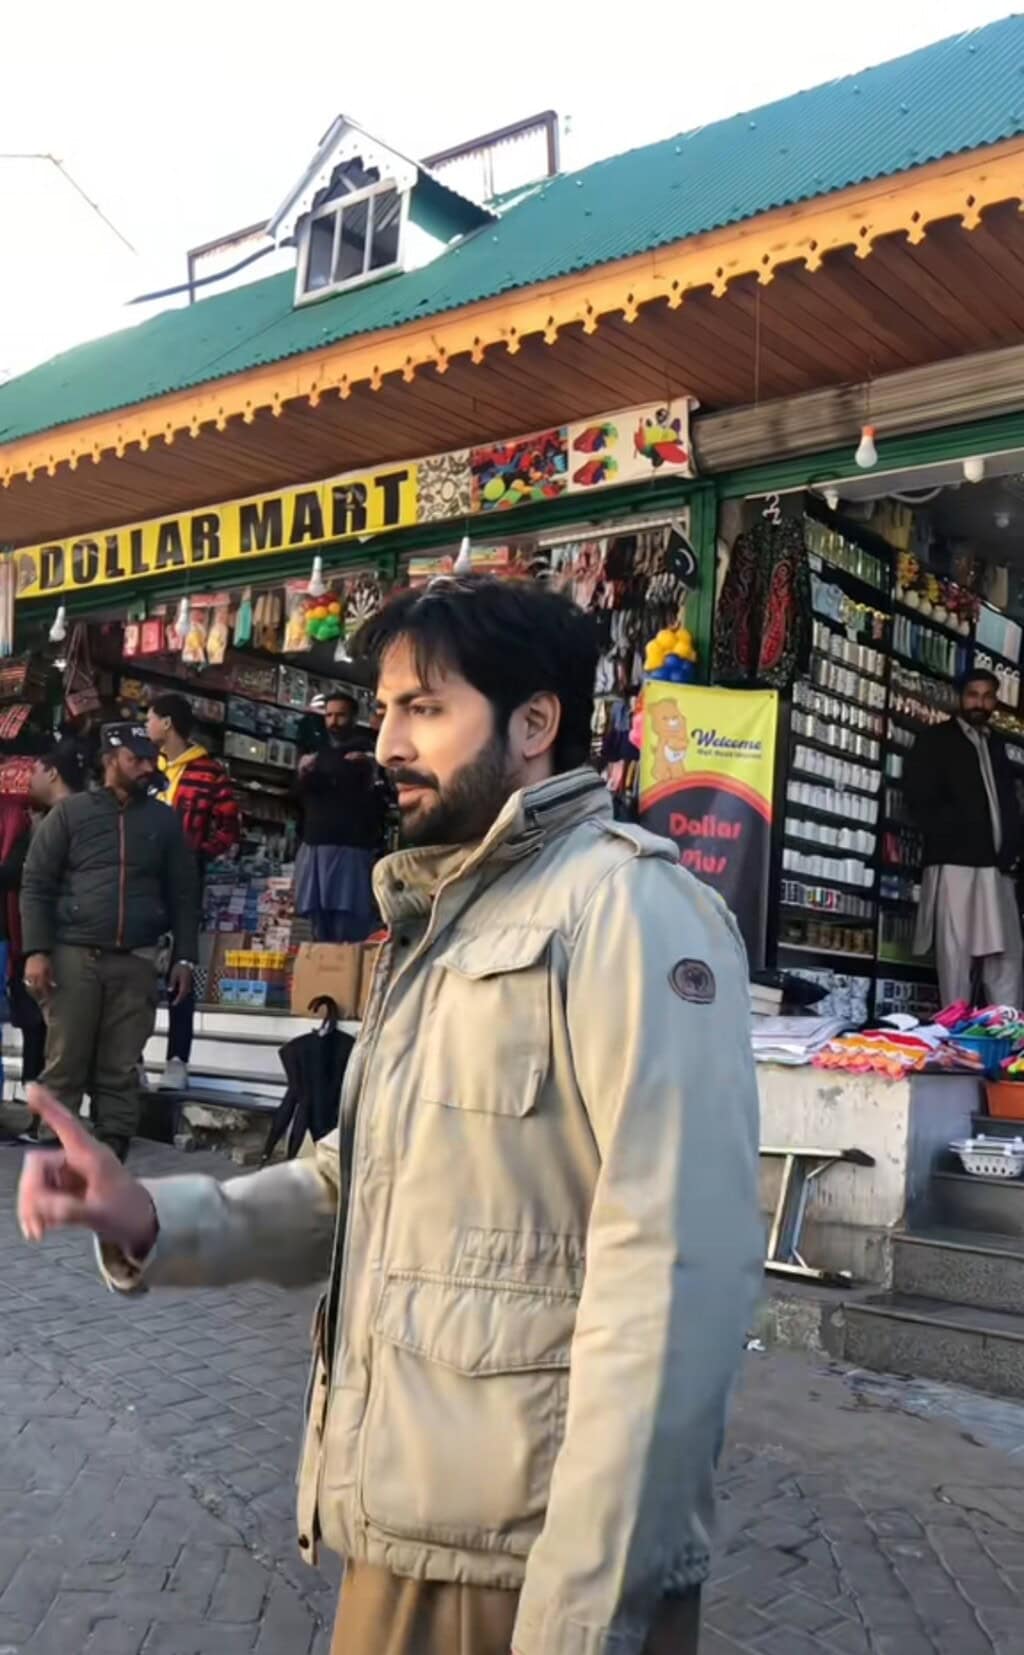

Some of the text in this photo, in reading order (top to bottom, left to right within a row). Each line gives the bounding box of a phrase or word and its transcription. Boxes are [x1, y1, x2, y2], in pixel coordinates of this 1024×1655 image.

[39, 469, 409, 590] DOLLAR MART
[690, 728, 762, 750] Welcome
[669, 812, 742, 839] Dollar
